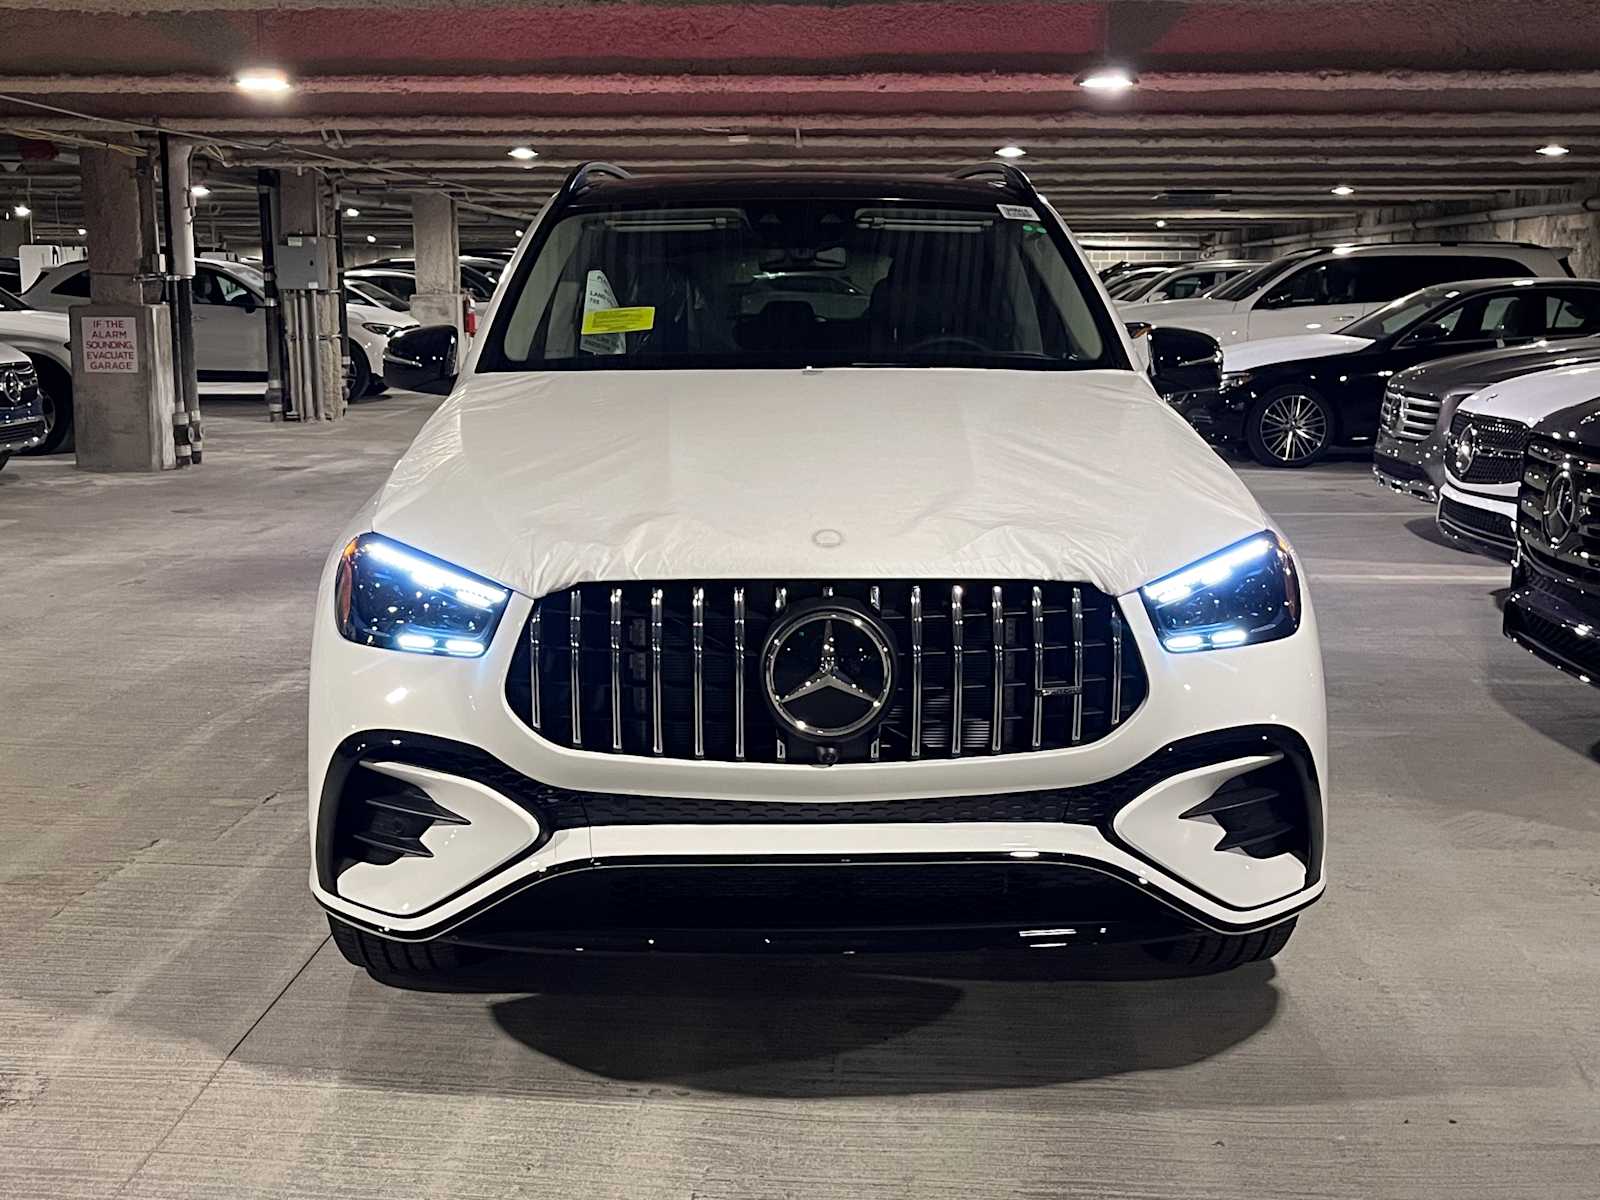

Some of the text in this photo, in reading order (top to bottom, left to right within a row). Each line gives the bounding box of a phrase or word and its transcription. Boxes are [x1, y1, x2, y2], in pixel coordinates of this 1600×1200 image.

[93, 320, 124, 328] IF THE
[91, 330, 127, 339] ALARM
[86, 351, 134, 360] EVACUATE
[90, 361, 133, 370] GARAGE
